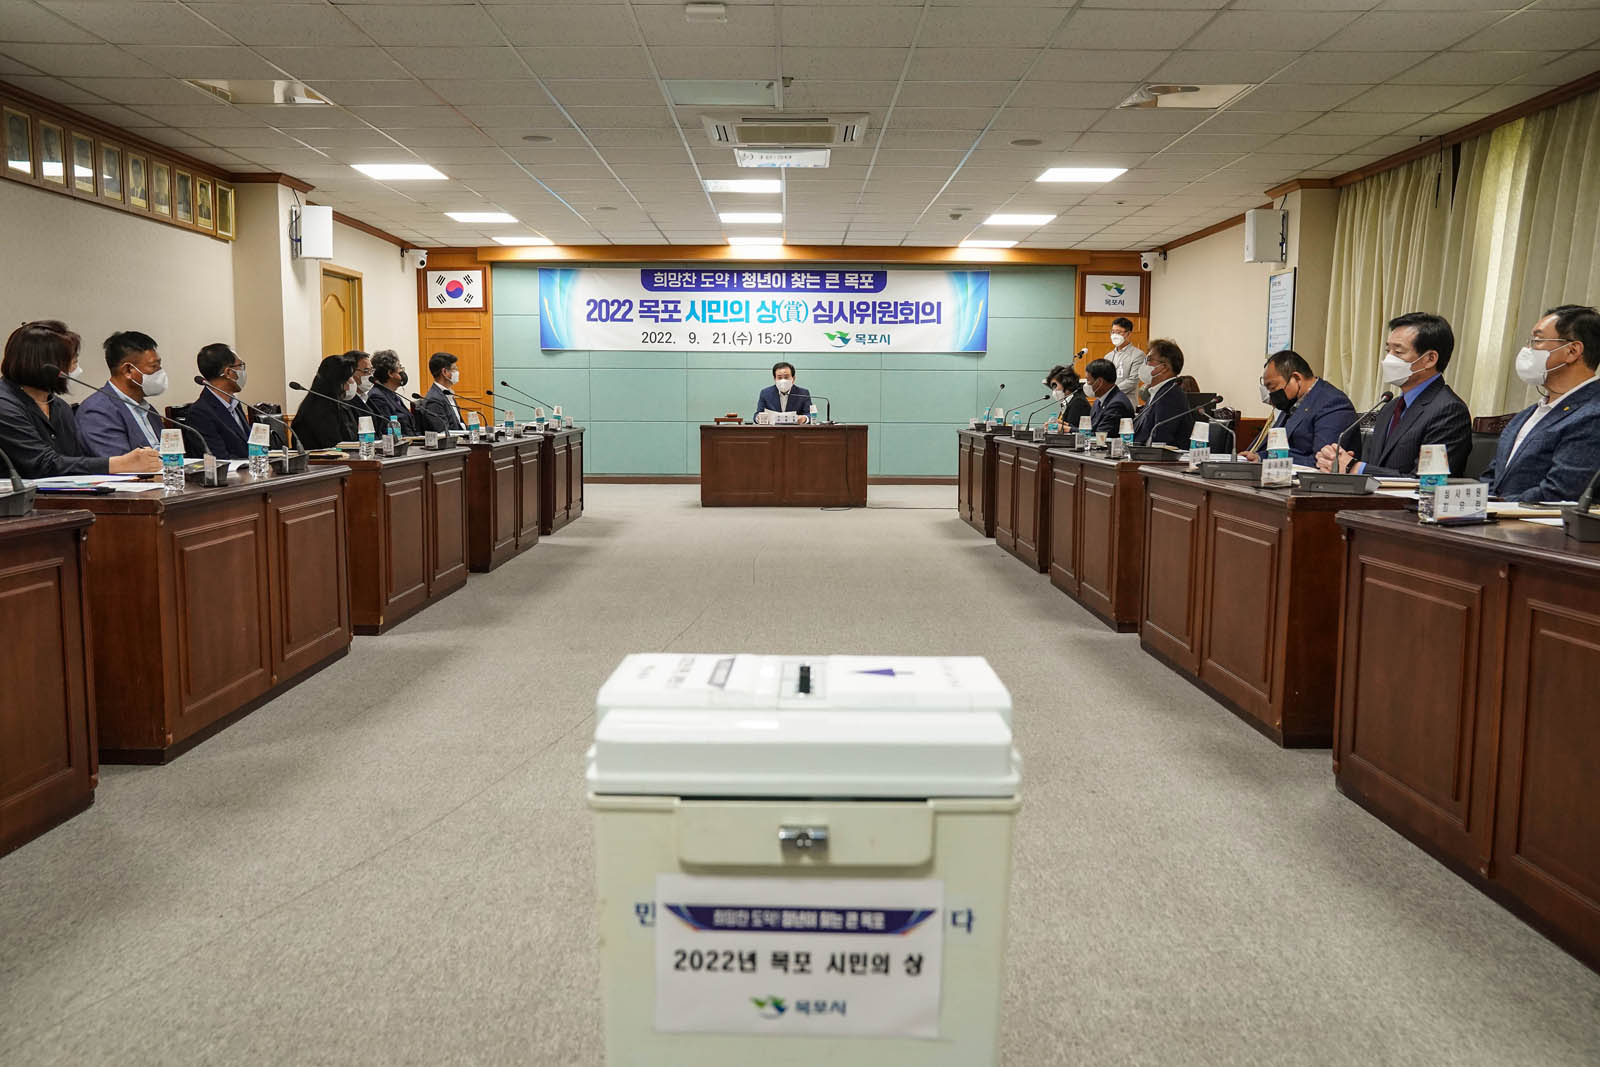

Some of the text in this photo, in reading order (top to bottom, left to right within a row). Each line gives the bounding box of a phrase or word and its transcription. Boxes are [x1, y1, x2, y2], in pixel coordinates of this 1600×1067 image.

[653, 271, 697, 288] 희망찬
[741, 272, 786, 288] 청년이
[791, 272, 821, 289] 찾는
[824, 272, 840, 289] 큰
[844, 273, 874, 290] 목포
[586, 299, 634, 323] 2022
[638, 299, 682, 324] 목포
[685, 299, 750, 324] 시민의
[812, 300, 942, 325] 심사위원회의
[641, 331, 793, 346] 2022. 9. 21.(수) 15:20
[855, 333, 891, 346] 목포시
[674, 950, 757, 973] 2022년
[826, 953, 891, 976] 시민의
[904, 953, 924, 977] 상
